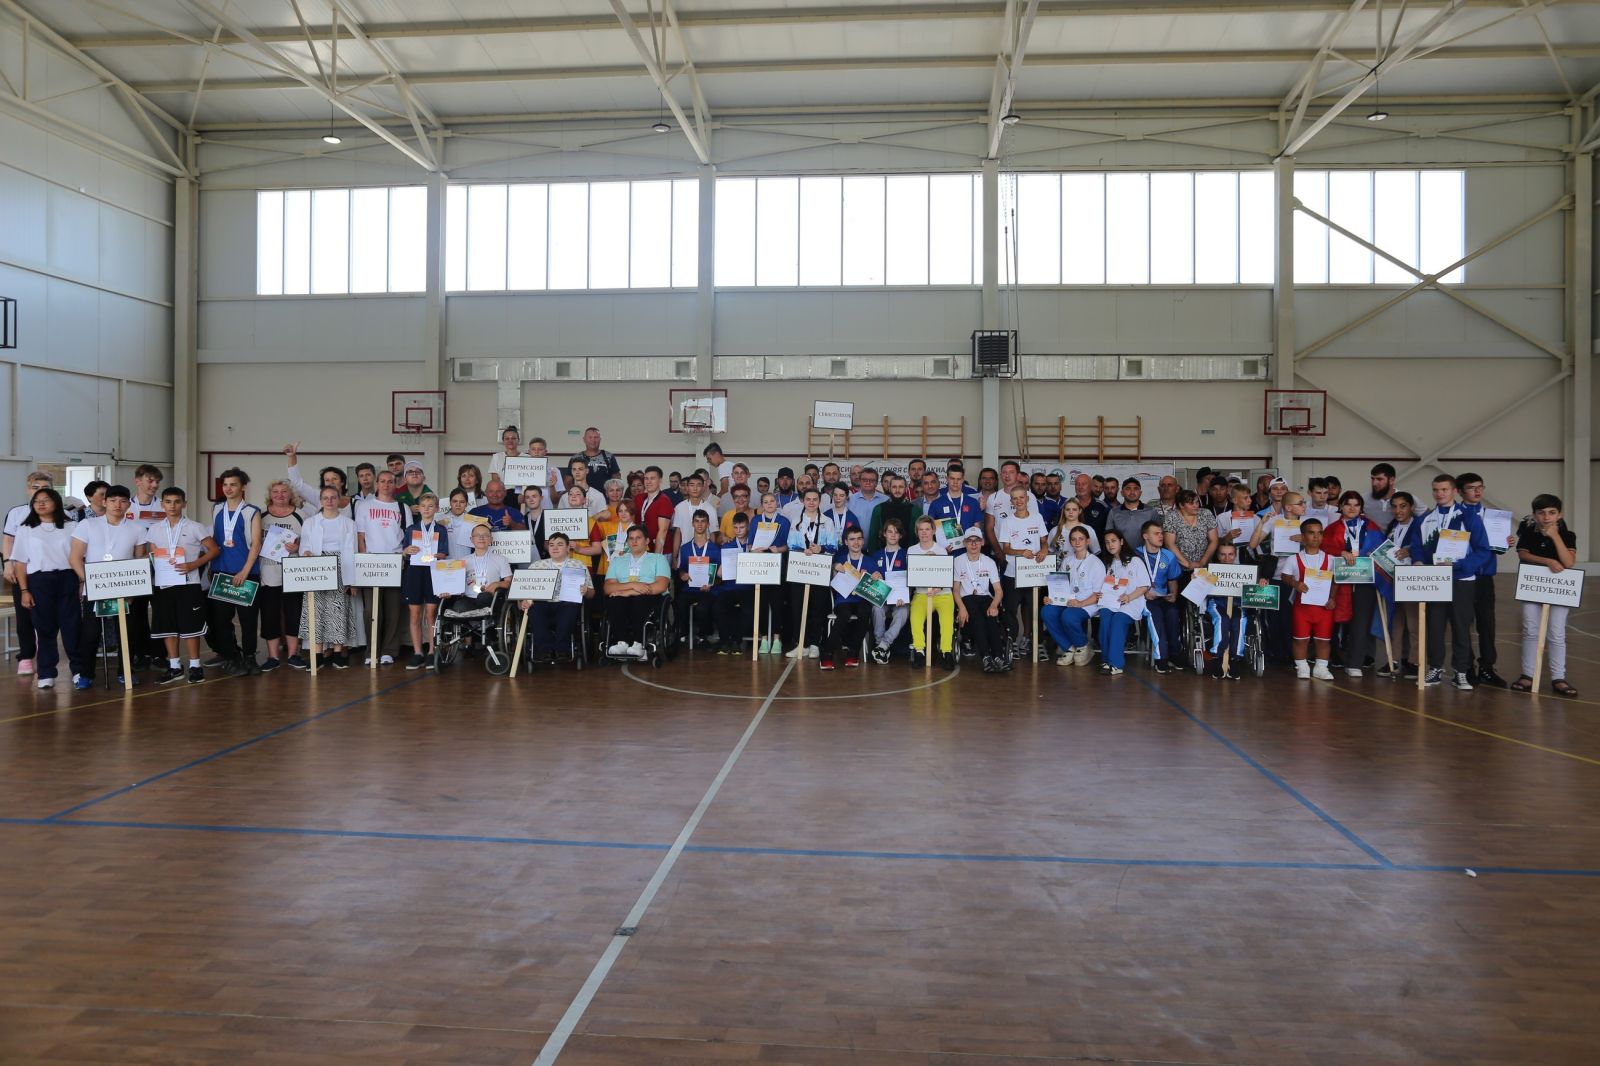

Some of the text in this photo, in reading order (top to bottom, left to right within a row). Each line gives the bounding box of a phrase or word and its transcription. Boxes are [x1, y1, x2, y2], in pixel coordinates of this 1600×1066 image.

[738, 560, 780, 568] РЕСПУБЛИКА
[789, 560, 831, 569] АРХАНГЕЛЬСКАЯ
[89, 569, 147, 580] РЕСПУБЛИКА
[283, 566, 337, 574] САРАТОВСКАЯ
[95, 579, 146, 589] КАЛМЫКИЯ
[1523, 574, 1576, 586] ЧЕЧЕНСКАЯ
[1519, 583, 1577, 597] РЕСПУБЛИКА
